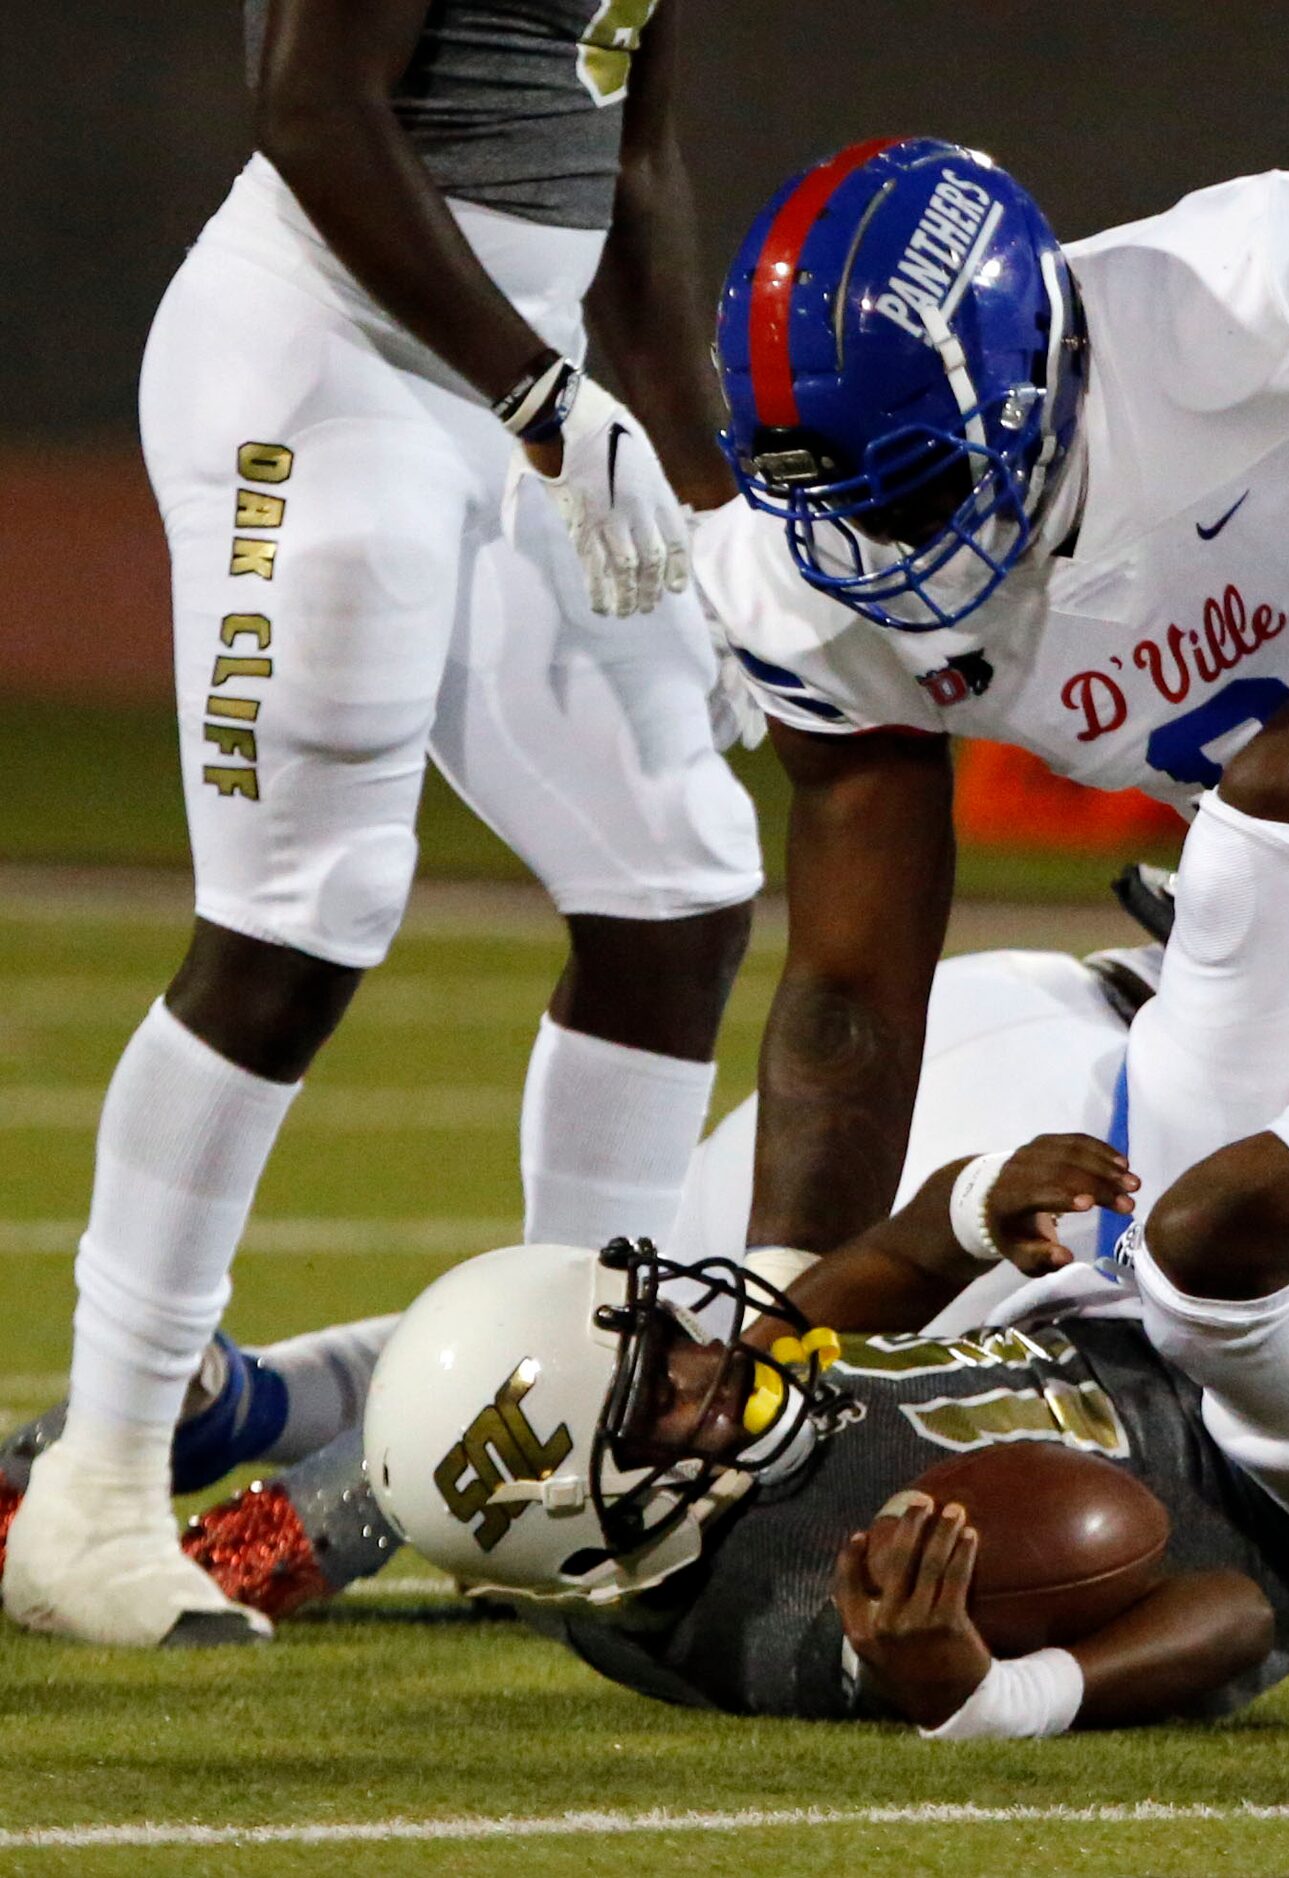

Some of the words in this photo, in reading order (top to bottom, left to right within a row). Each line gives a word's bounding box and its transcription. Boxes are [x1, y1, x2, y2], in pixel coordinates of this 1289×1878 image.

[875, 168, 991, 346] PANTHERS
[230, 441, 294, 581] OAK
[202, 613, 273, 802] CLIFF
[1060, 583, 1287, 742] D'Ville
